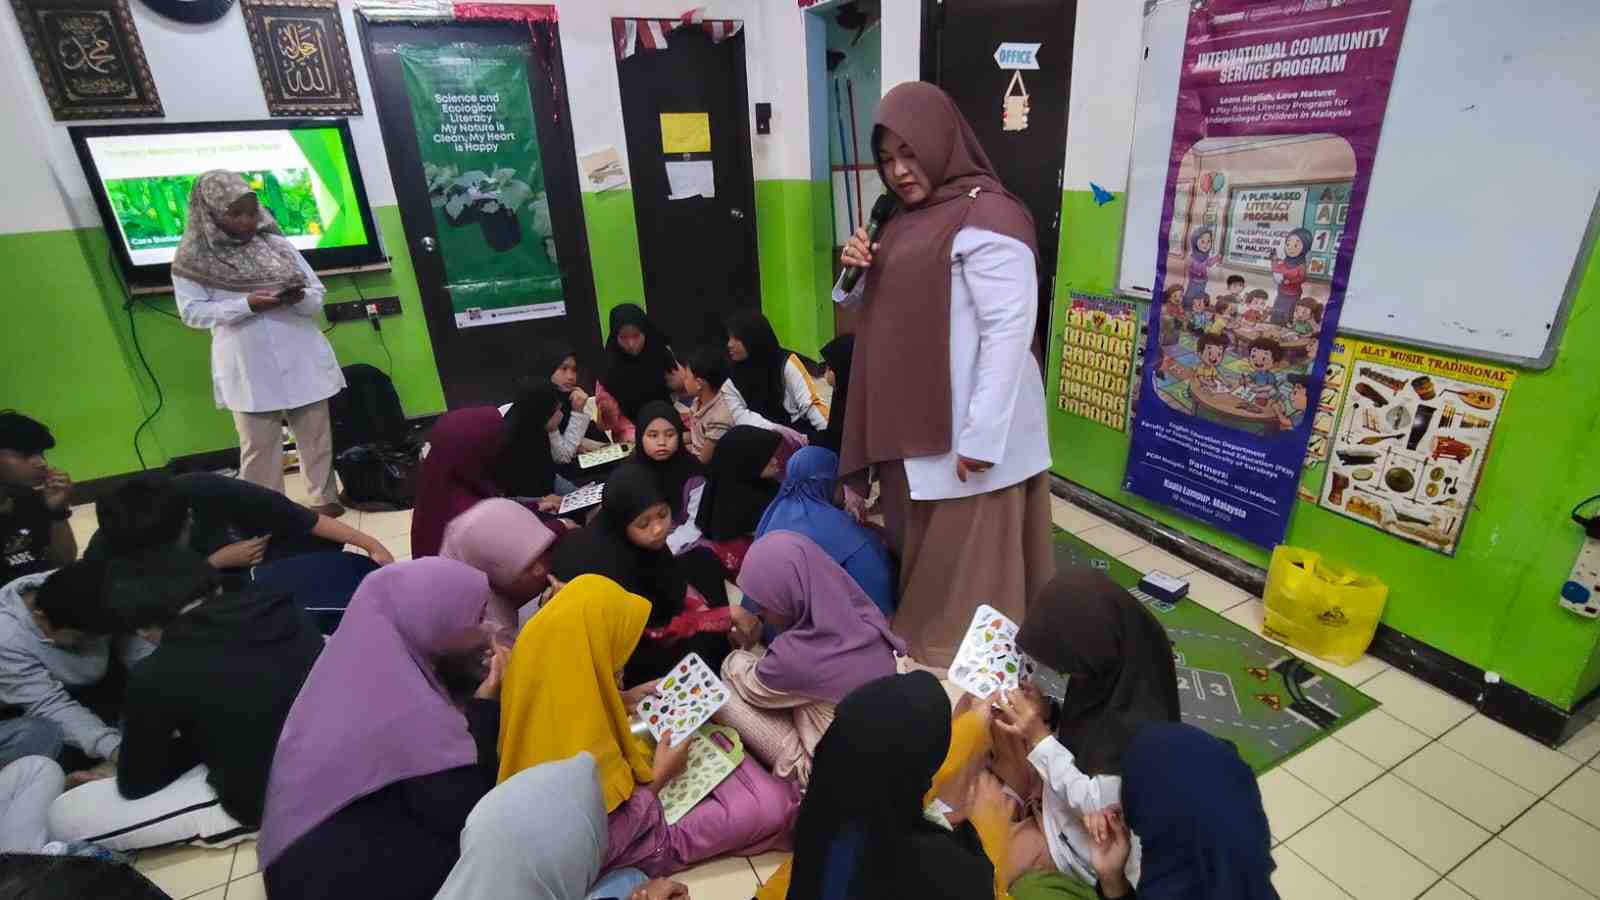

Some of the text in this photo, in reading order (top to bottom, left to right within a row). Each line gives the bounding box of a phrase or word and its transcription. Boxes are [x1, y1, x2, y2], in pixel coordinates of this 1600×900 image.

[1197, 27, 1389, 70] INTERNATIONAL COMMUNITY
[1000, 48, 1032, 64] OFFICE
[1220, 54, 1347, 84] SERVICE PROGRAM
[434, 92, 500, 103] Science and
[442, 103, 496, 114] Ecological
[1257, 101, 1291, 113] Literacy
[1292, 100, 1333, 110] Program
[1334, 98, 1349, 106] for
[450, 113, 492, 123] Literacy
[1263, 111, 1298, 121] Children
[1299, 110, 1309, 119] in
[1310, 107, 1352, 119] Malaysia
[441, 124, 457, 134] My
[460, 123, 494, 132] Nature
[433, 131, 515, 143] Clean, My Heart
[465, 142, 498, 152] Happy
[1249, 191, 1302, 201] PLAY-BASED
[1243, 213, 1289, 221] PROGRAM
[1360, 344, 1506, 382] ALAT MUSIK TRADISIONAL
[1222, 441, 1267, 459] Department
[1189, 458, 1229, 479] Partners:
[1164, 478, 1182, 493] Kuala
[1213, 498, 1247, 518] Malaysia
[1177, 676, 1191, 689] 2
[1209, 682, 1228, 697] 3
